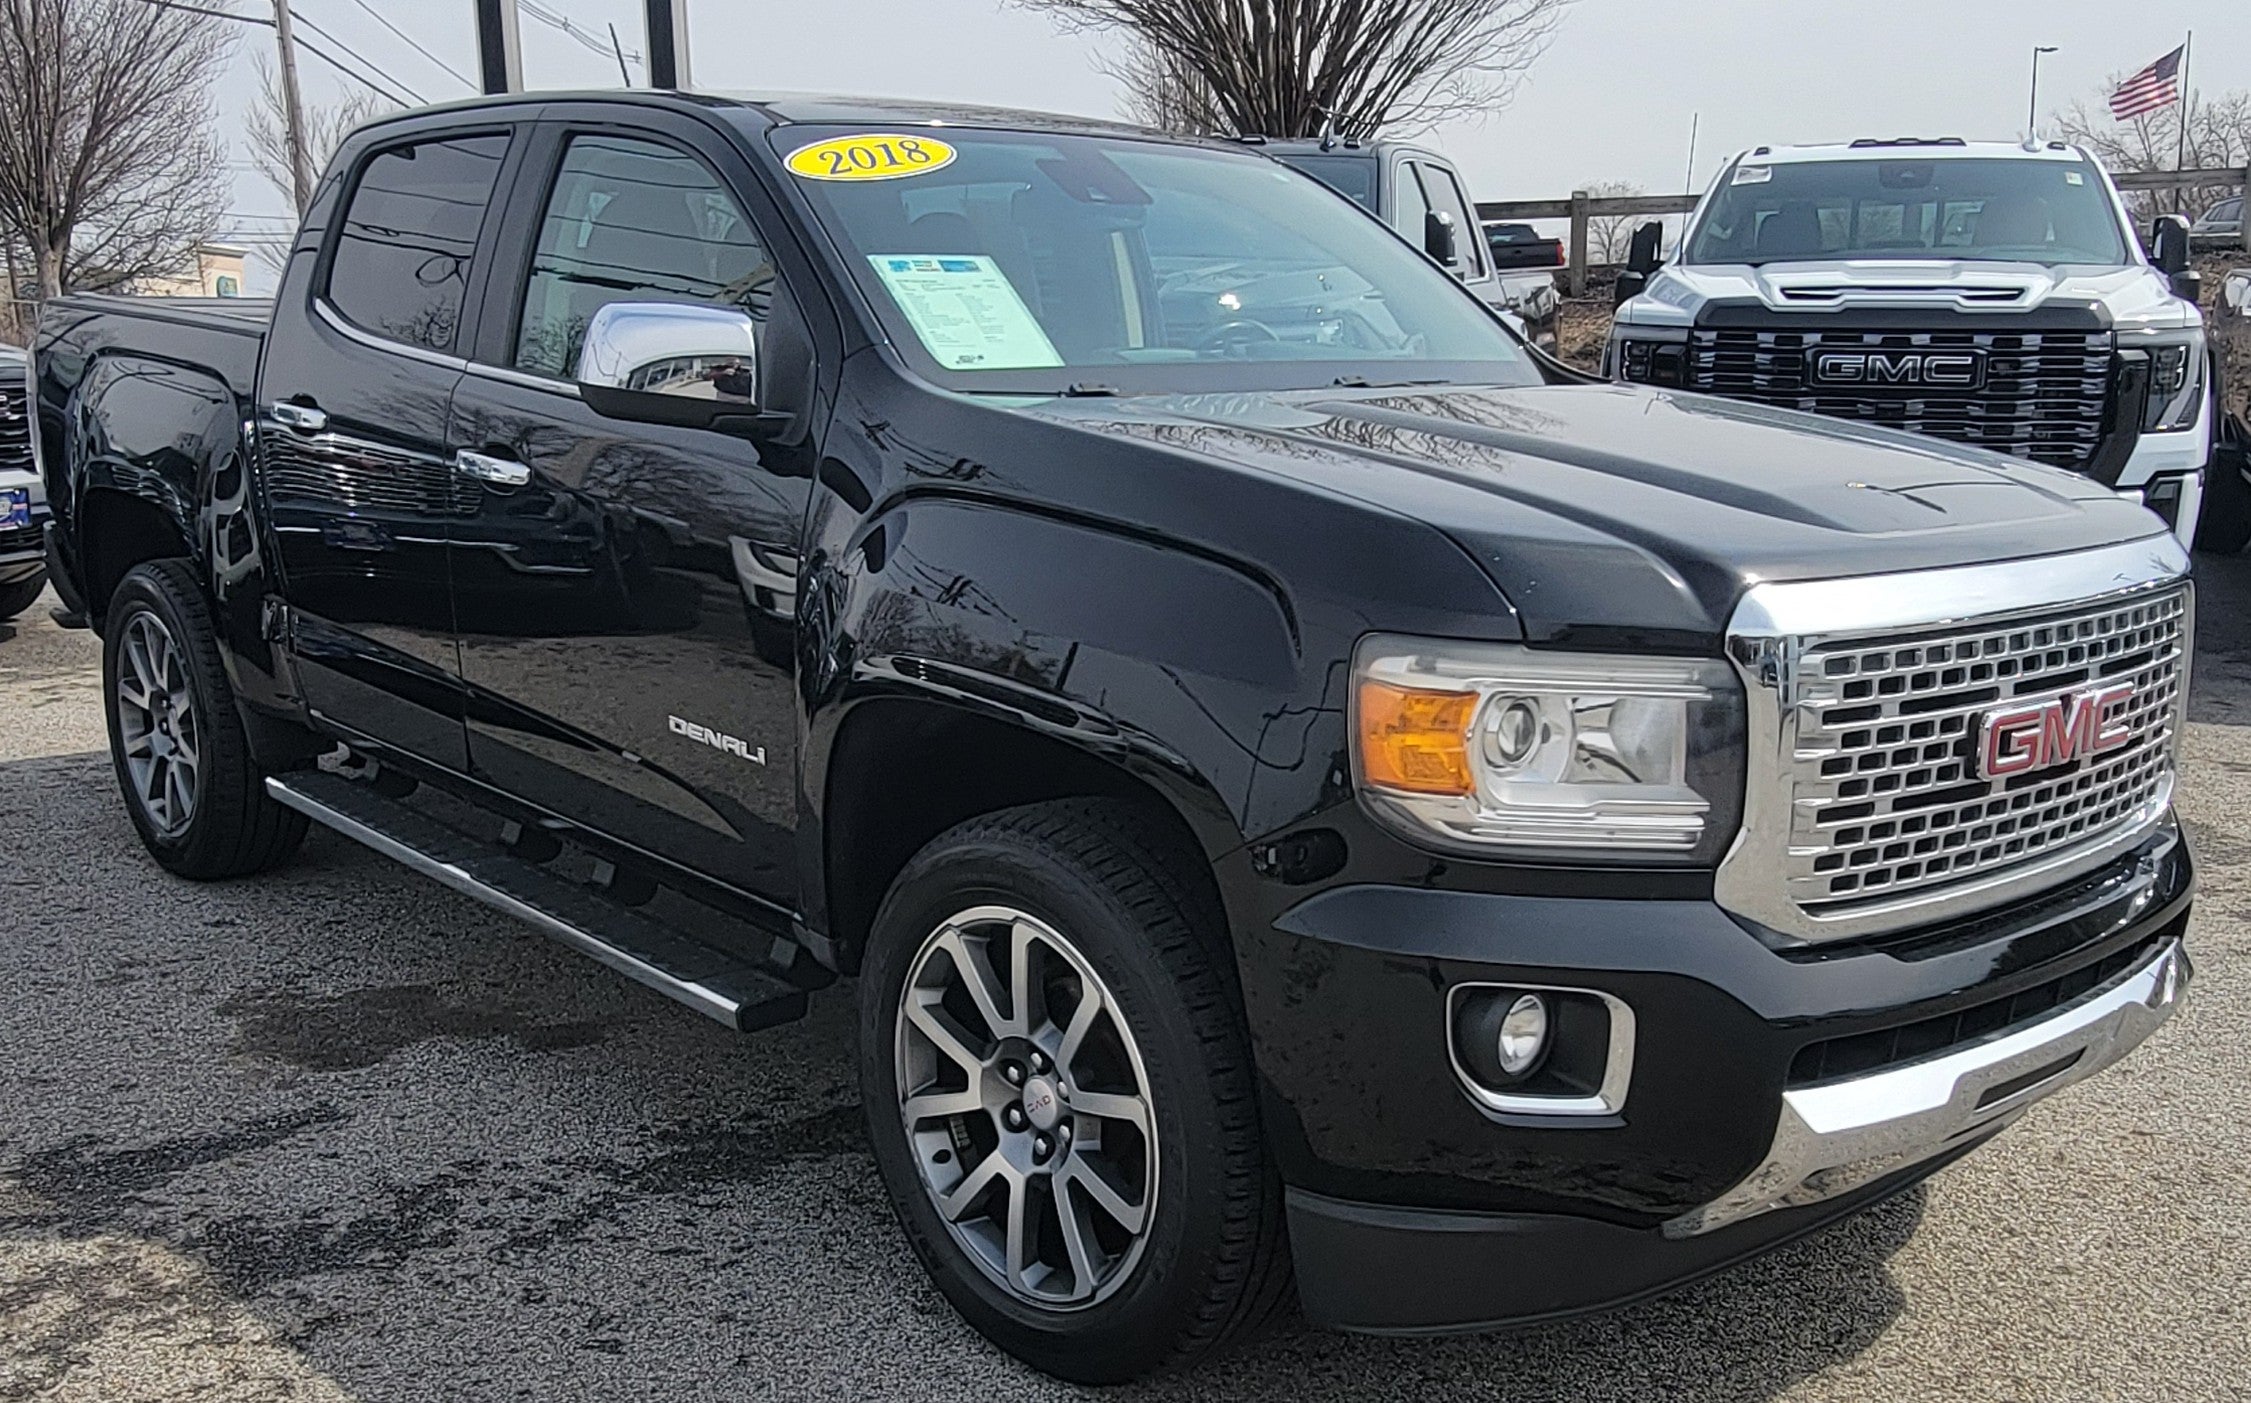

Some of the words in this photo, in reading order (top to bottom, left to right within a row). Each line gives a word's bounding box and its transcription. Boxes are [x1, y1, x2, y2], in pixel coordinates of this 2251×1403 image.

[819, 139, 931, 175] 2018
[1817, 354, 1973, 383] GMC
[668, 714, 766, 767] DENALI
[1977, 681, 2135, 781] GMC
